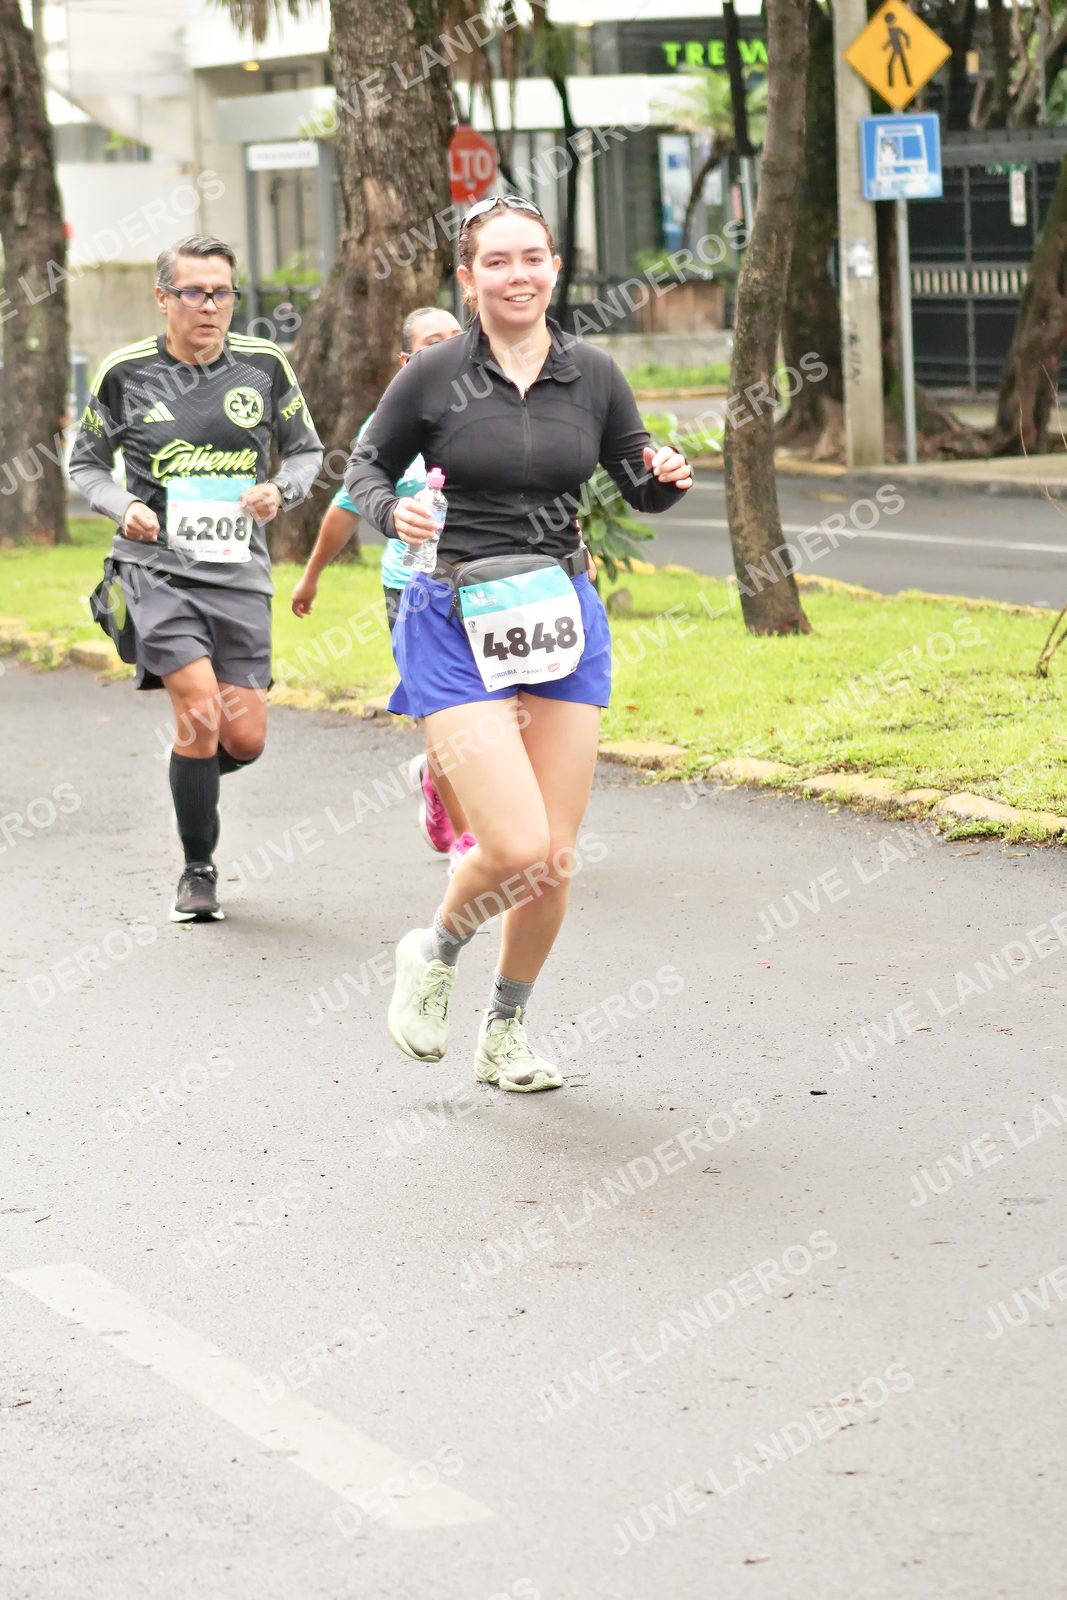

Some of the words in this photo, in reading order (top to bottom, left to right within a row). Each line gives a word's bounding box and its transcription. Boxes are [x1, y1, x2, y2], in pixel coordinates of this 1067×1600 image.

[448, 148, 492, 181] LTO
[149, 438, 258, 479] Caliente
[176, 516, 248, 541] 4208
[483, 616, 578, 661] 4848
